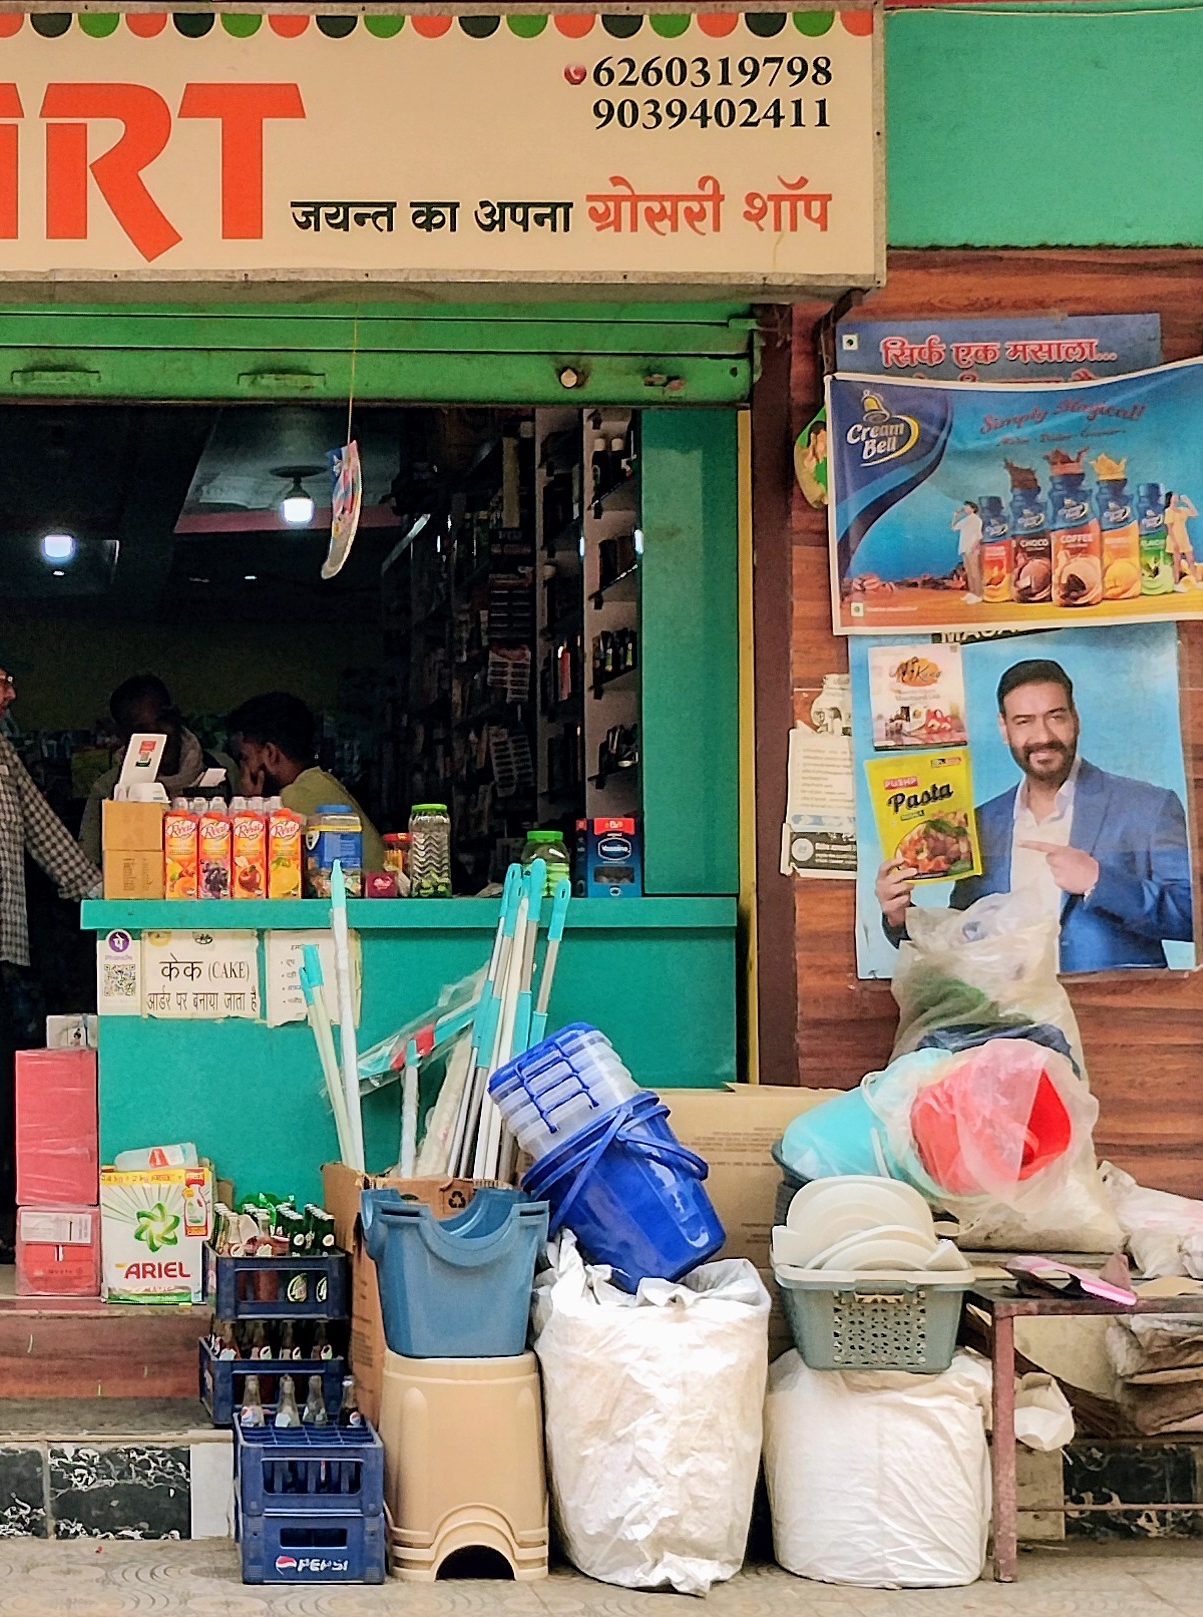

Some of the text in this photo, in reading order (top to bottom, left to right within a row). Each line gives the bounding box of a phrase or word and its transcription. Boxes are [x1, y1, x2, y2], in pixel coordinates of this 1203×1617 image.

[592, 56, 833, 87] 6260319798
[594, 98, 832, 130] 9039402411
[290, 176, 833, 236] जयन्त का अपना ग्रोसरी शॉप
[881, 335, 946, 368] सिर्फ
[951, 341, 1001, 368] एक
[847, 423, 904, 444] Cream
[862, 436, 896, 460] Bell
[886, 783, 955, 813] Pasta
[159, 953, 250, 981] केक (CAKE)
[176, 992, 188, 1011] पर
[193, 992, 219, 1011] बनाया
[224, 992, 246, 1011] जाता
[124, 1262, 191, 1279] ARIEL
[298, 1558, 349, 1573] PEPSI
